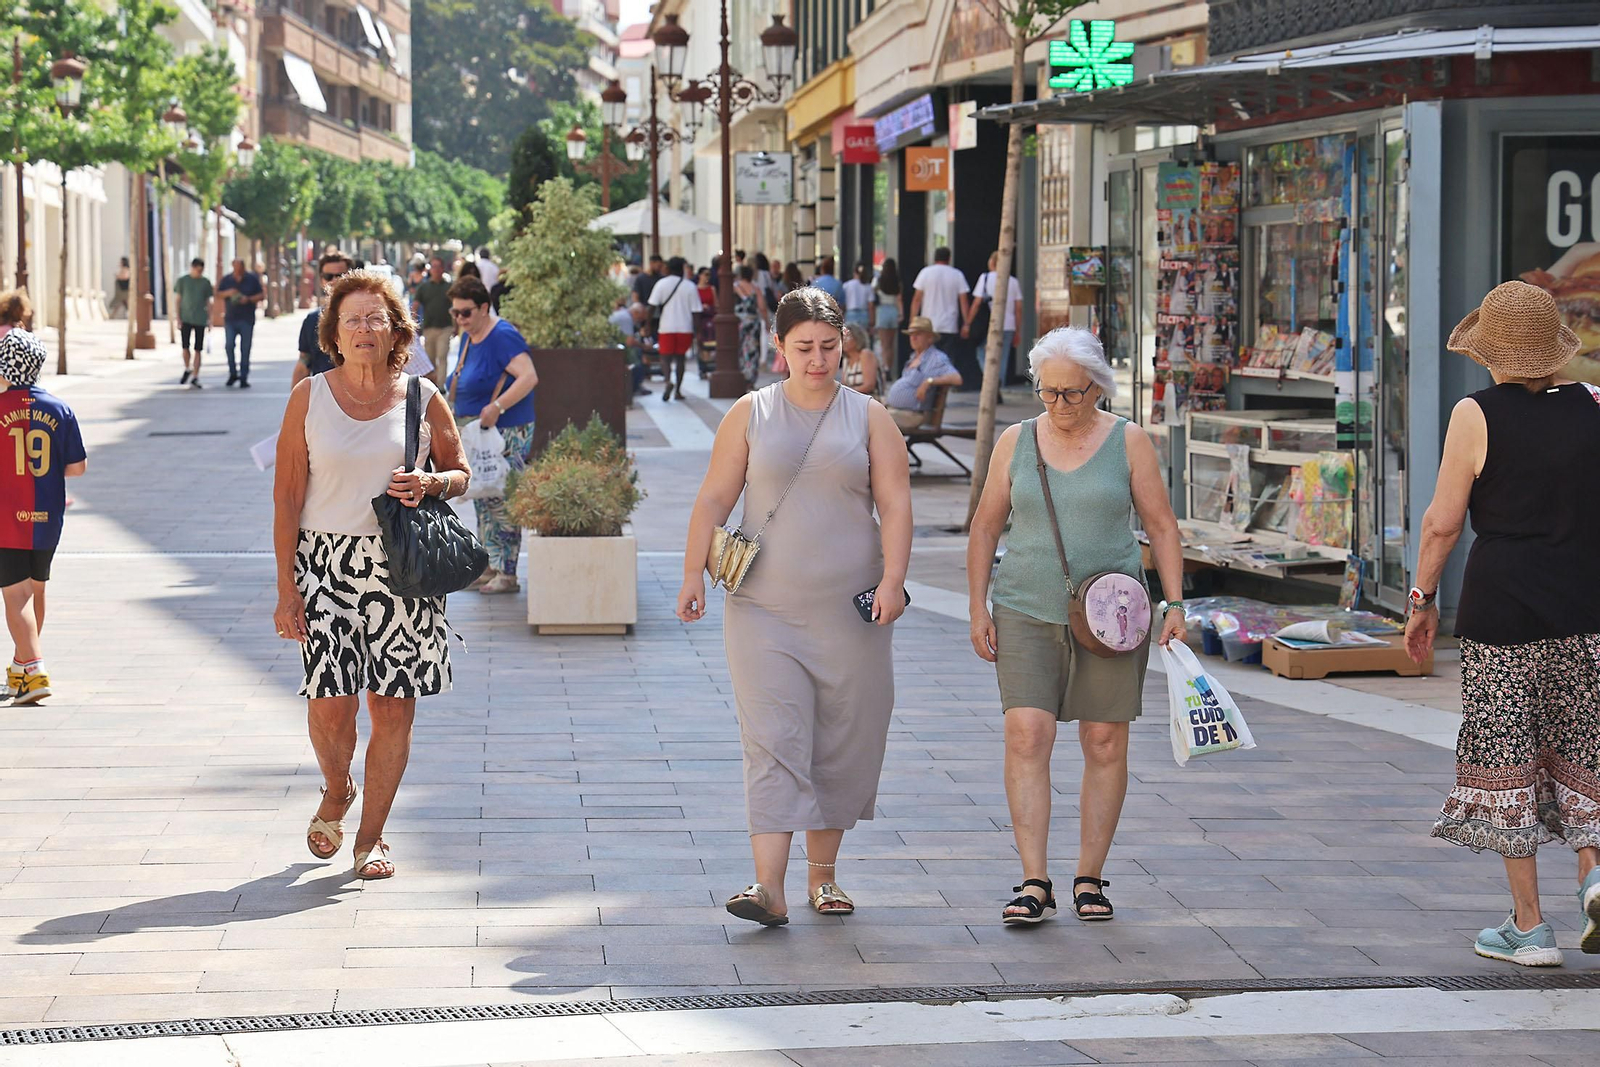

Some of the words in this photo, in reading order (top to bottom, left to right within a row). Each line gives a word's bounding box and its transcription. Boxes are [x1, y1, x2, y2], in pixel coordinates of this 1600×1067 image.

[1547, 170, 1600, 247] G
[0, 409, 31, 428] LAMINE
[32, 409, 59, 432] YAMAL
[8, 427, 51, 477] 19
[1184, 695, 1202, 708] TU
[1189, 706, 1225, 725] CUID
[1193, 724, 1220, 746] DE
